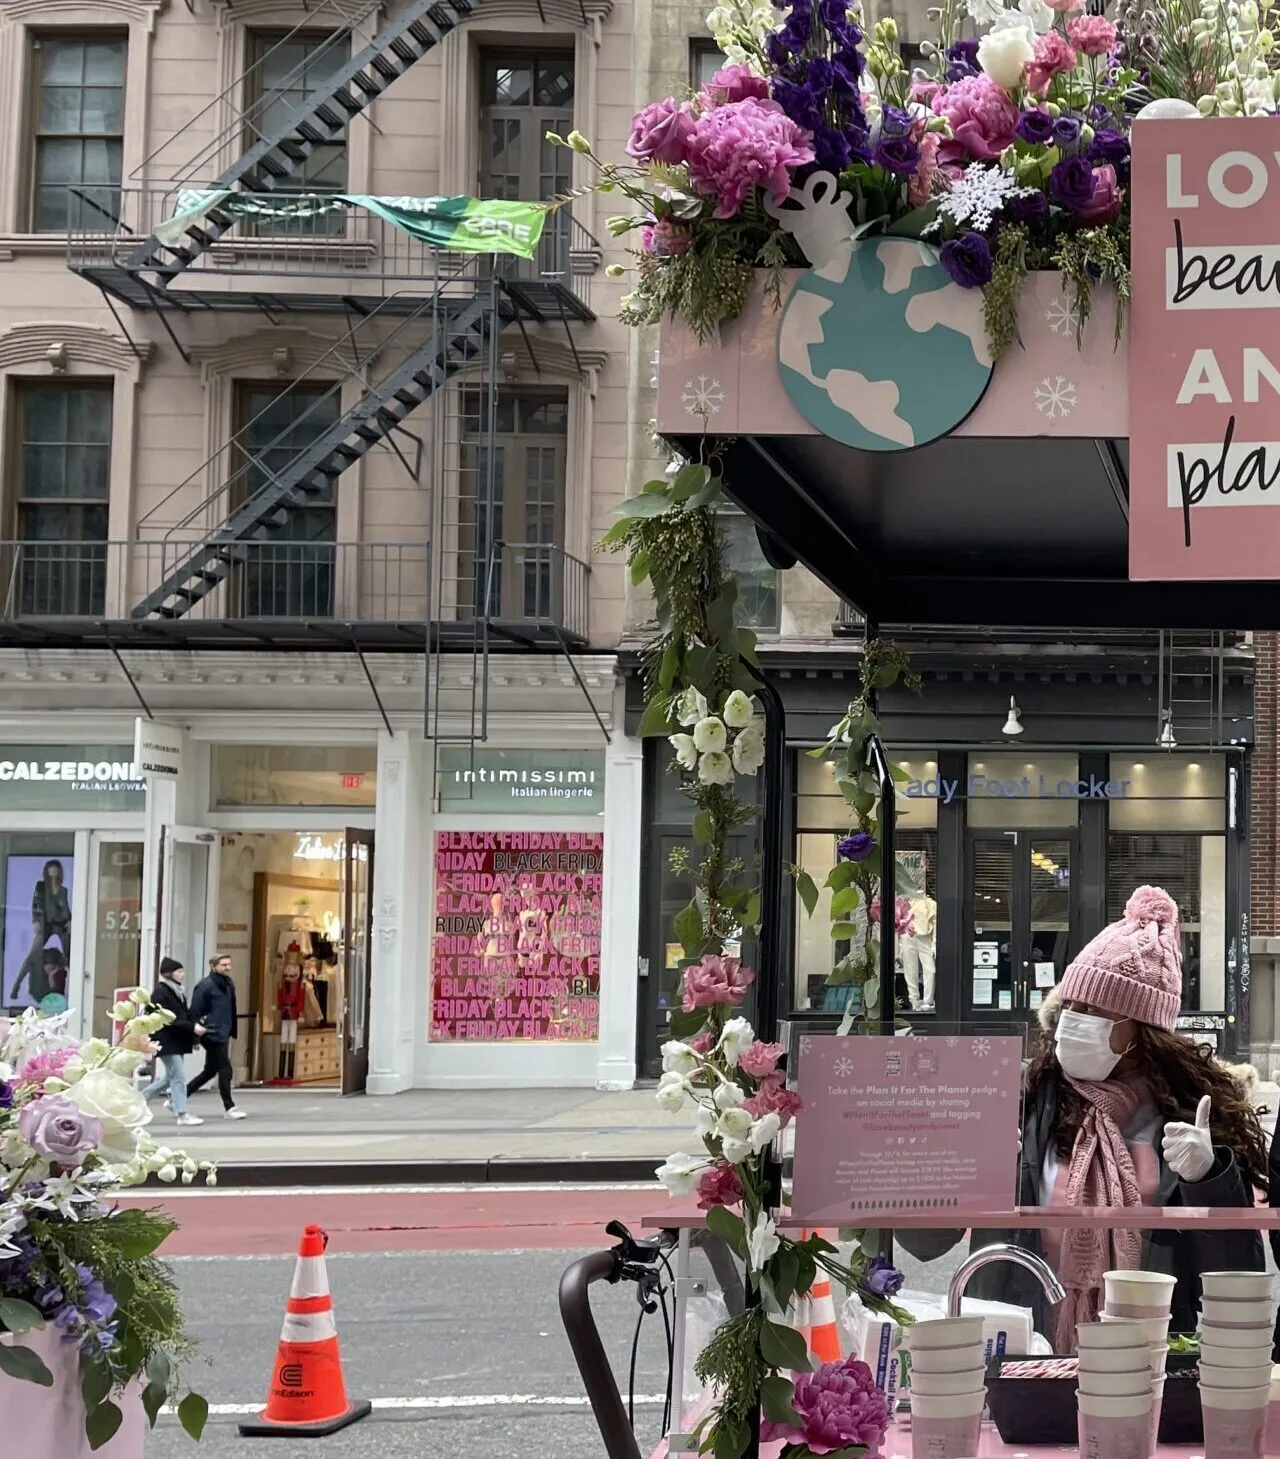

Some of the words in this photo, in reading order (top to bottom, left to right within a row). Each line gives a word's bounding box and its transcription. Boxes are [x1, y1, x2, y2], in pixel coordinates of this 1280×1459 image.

[0, 761, 143, 780] CALZEDONI
[455, 768, 595, 783] intimissimi
[511, 787, 547, 797] Italian
[550, 787, 593, 799] lingerie
[901, 773, 958, 803] ady
[968, 774, 1031, 797] Foot
[1038, 773, 1131, 797] Locker
[439, 832, 496, 850] BLACK
[500, 832, 562, 850] FRIDAY
[494, 853, 551, 871] BLACK
[452, 873, 515, 892] FRIDAY
[518, 873, 577, 892] BLACK
[437, 894, 492, 913] BLACK
[501, 894, 562, 913] FRIDAY
[489, 916, 548, 933] BLACK
[497, 936, 555, 955] BLACK
[457, 957, 519, 976] FRIDAY
[524, 957, 583, 976] BLACK
[440, 978, 498, 997] BLACK
[504, 978, 569, 997] FRIDAY
[494, 1000, 550, 1018] BLACK
[455, 1021, 519, 1040] FRIDAY
[523, 1021, 582, 1040] BLACK
[866, 1085, 888, 1094] Plan
[900, 1085, 915, 1094] For
[918, 1085, 934, 1093] The
[938, 1085, 968, 1094] Planet
[869, 1098, 894, 1107] social
[897, 1098, 924, 1106] media
[926, 1098, 935, 1108] by
[931, 1110, 946, 1119] and
[888, 1358, 898, 1393] Cocktail
